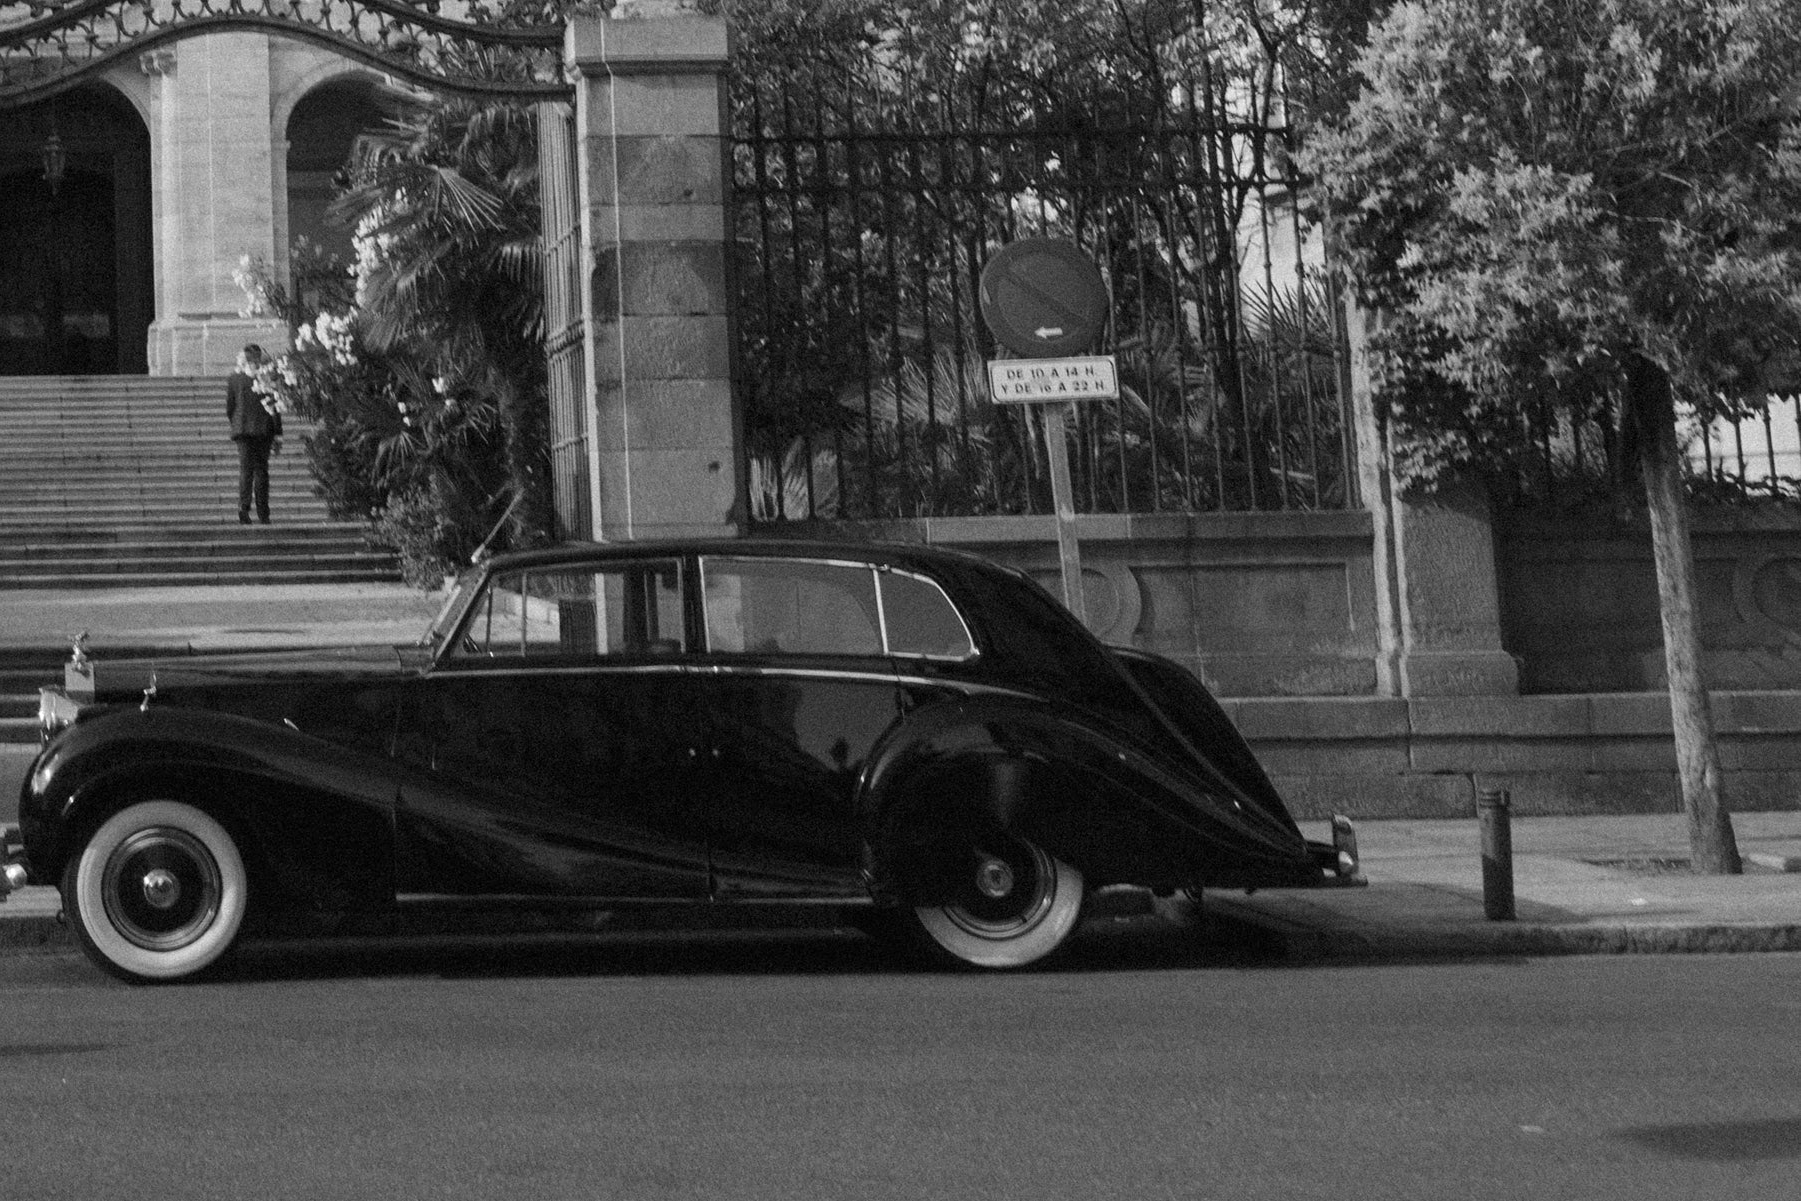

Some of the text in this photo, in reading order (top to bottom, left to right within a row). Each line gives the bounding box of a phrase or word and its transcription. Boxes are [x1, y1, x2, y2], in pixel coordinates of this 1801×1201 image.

[1006, 368, 1023, 380] DE
[1031, 367, 1045, 379] 10
[1051, 367, 1060, 377] A
[1065, 366, 1078, 377] 14
[1014, 382, 1031, 394] DE
[1058, 381, 1067, 392] A
[1072, 380, 1088, 391] 22
